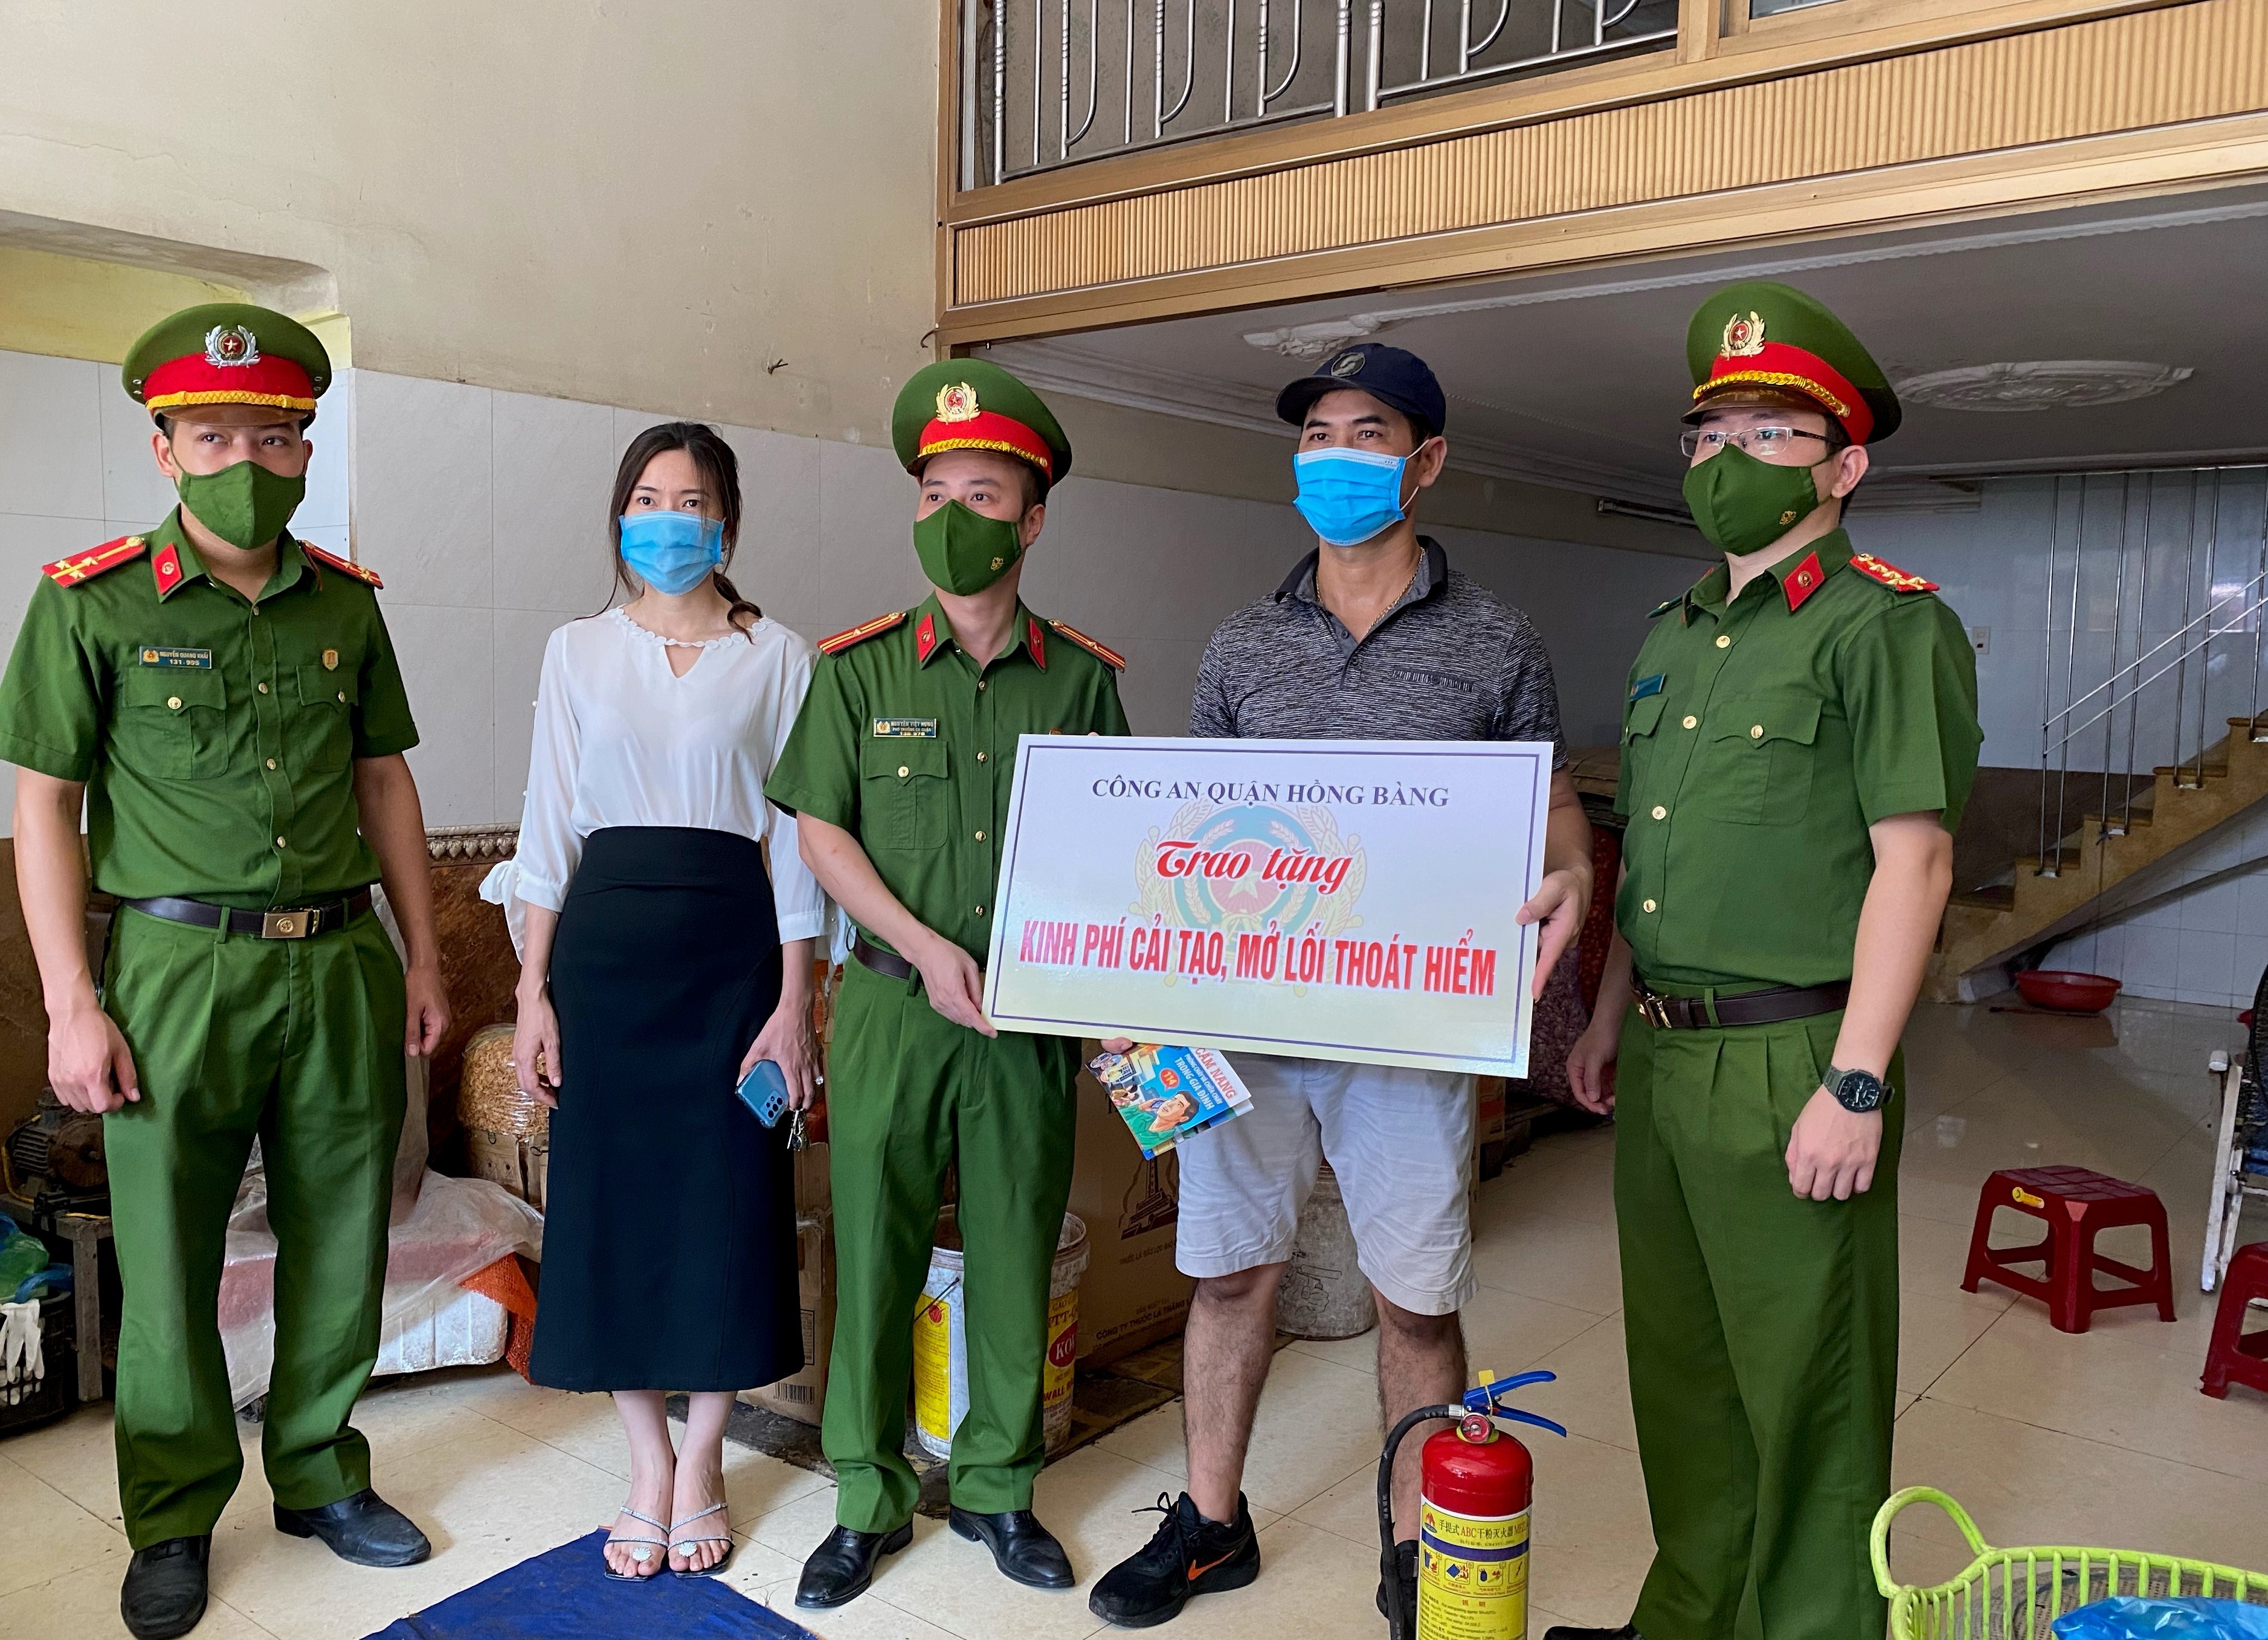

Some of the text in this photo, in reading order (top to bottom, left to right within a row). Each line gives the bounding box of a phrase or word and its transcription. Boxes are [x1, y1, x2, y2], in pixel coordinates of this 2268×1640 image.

[1092, 775, 1449, 807] CÔNG AN QUẬN HỒNG BÀNG
[1156, 841, 1353, 894] Trao tặng
[1019, 913, 1496, 996] KINH PHÍ CẢI TẠO, MỞ LỐI THOÁT HIỂM
[1163, 1071, 1177, 1085] 114
[1174, 1057, 1216, 1111] TRONG GIA ĐÌNH
[1210, 1067, 1237, 1100] NANG
[1439, 1519, 1460, 1536] 手提式
[1461, 1526, 1477, 1538] ABC
